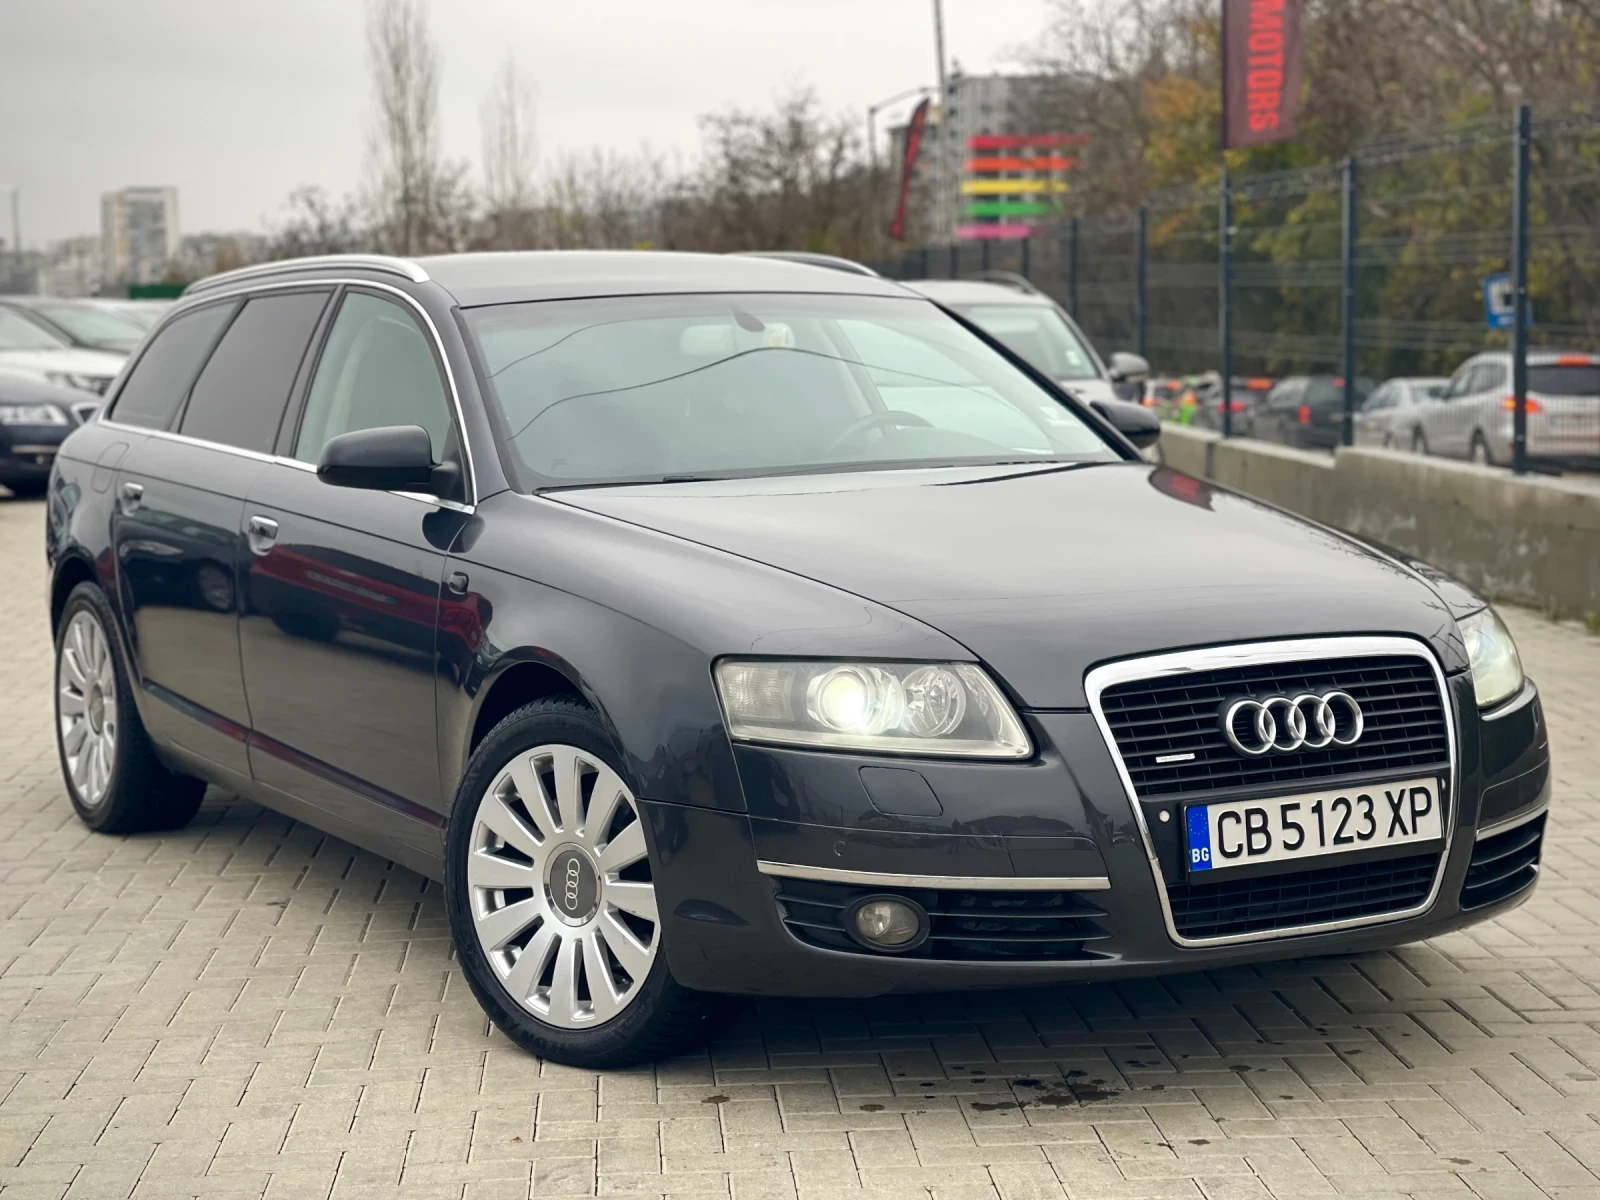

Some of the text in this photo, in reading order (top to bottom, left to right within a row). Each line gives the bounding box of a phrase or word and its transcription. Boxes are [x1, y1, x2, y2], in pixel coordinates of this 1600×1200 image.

[1246, 0, 1285, 132] MOTORS
[1191, 847, 1210, 863] BG
[1217, 786, 1432, 859] CB 5123 XP
